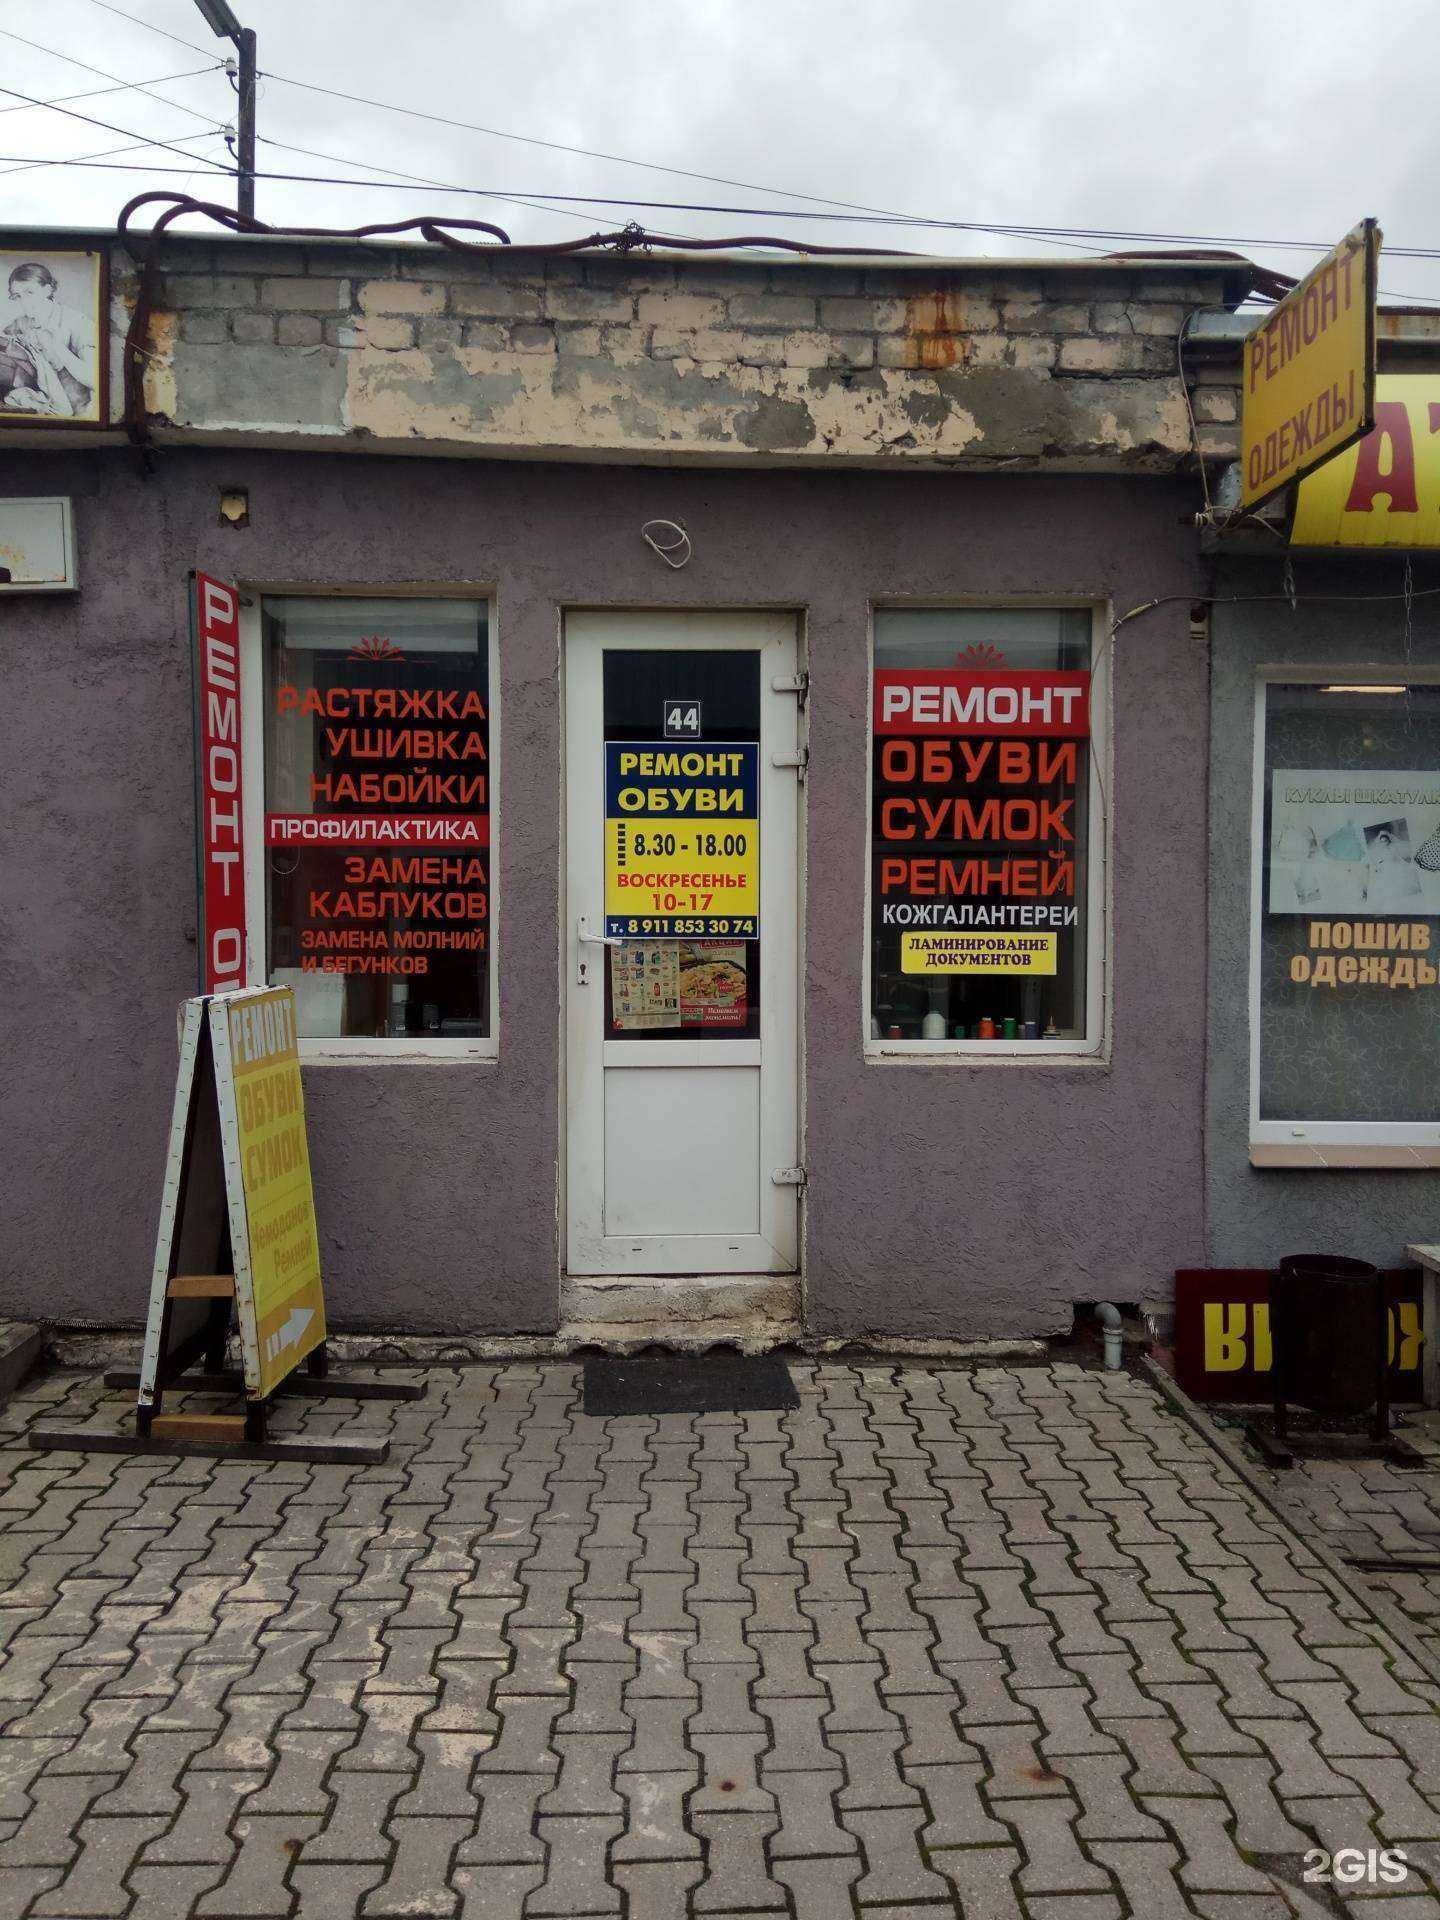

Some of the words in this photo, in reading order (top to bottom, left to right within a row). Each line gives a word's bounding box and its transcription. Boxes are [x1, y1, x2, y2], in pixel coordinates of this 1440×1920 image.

[1250, 249, 1357, 394] РЕМОНТ
[1250, 370, 1355, 490] ОДЕЖДЫ
[276, 687, 486, 720] РАСТЯЖКА
[882, 685, 1082, 724] РЕМОНТ
[667, 707, 699, 730] 44
[205, 579, 240, 897] РЕМОНТ
[326, 727, 487, 760] УШИВКА
[619, 752, 744, 777] РЕМОНТ
[881, 740, 1077, 785] ОБУВИ
[310, 766, 486, 804] НАБОЙКИ
[617, 787, 744, 812] ОБУВИ
[270, 818, 480, 840] ПРОФИЛАКТИКА
[880, 798, 1075, 841] СУМОК
[634, 833, 676, 857] 8.30
[695, 833, 747, 857] 18.00
[344, 856, 487, 885] ЗАМЕНА
[617, 873, 747, 888] ВОСКРЕСЕНЬЕ
[880, 850, 1075, 896] РЕМНЕЙ
[309, 891, 488, 919] КАБЛУКОВ
[652, 893, 714, 911] 10-17
[882, 904, 1079, 926] КОЖГАЛАНТЕРЕИ
[301, 929, 389, 949] ЗАМЕНА
[393, 928, 486, 949] МОЛНИЙ
[628, 919, 638, 934] 8
[643, 919, 669, 934] 911
[674, 919, 705, 934] 853
[708, 919, 730, 934] 30
[733, 919, 754, 934] 74
[908, 937, 1049, 951] ЛАМИНИРОВАНИЕ
[213, 927, 241, 994] О
[302, 955, 317, 975] И
[322, 955, 429, 975] БЕГУНКОВ
[925, 953, 1032, 968] ДОКУМЕНТОВ
[230, 998, 294, 1066] РЕМОНТ
[240, 1067, 300, 1134] ОБУВИ
[246, 1125, 304, 1193] СУМОК
